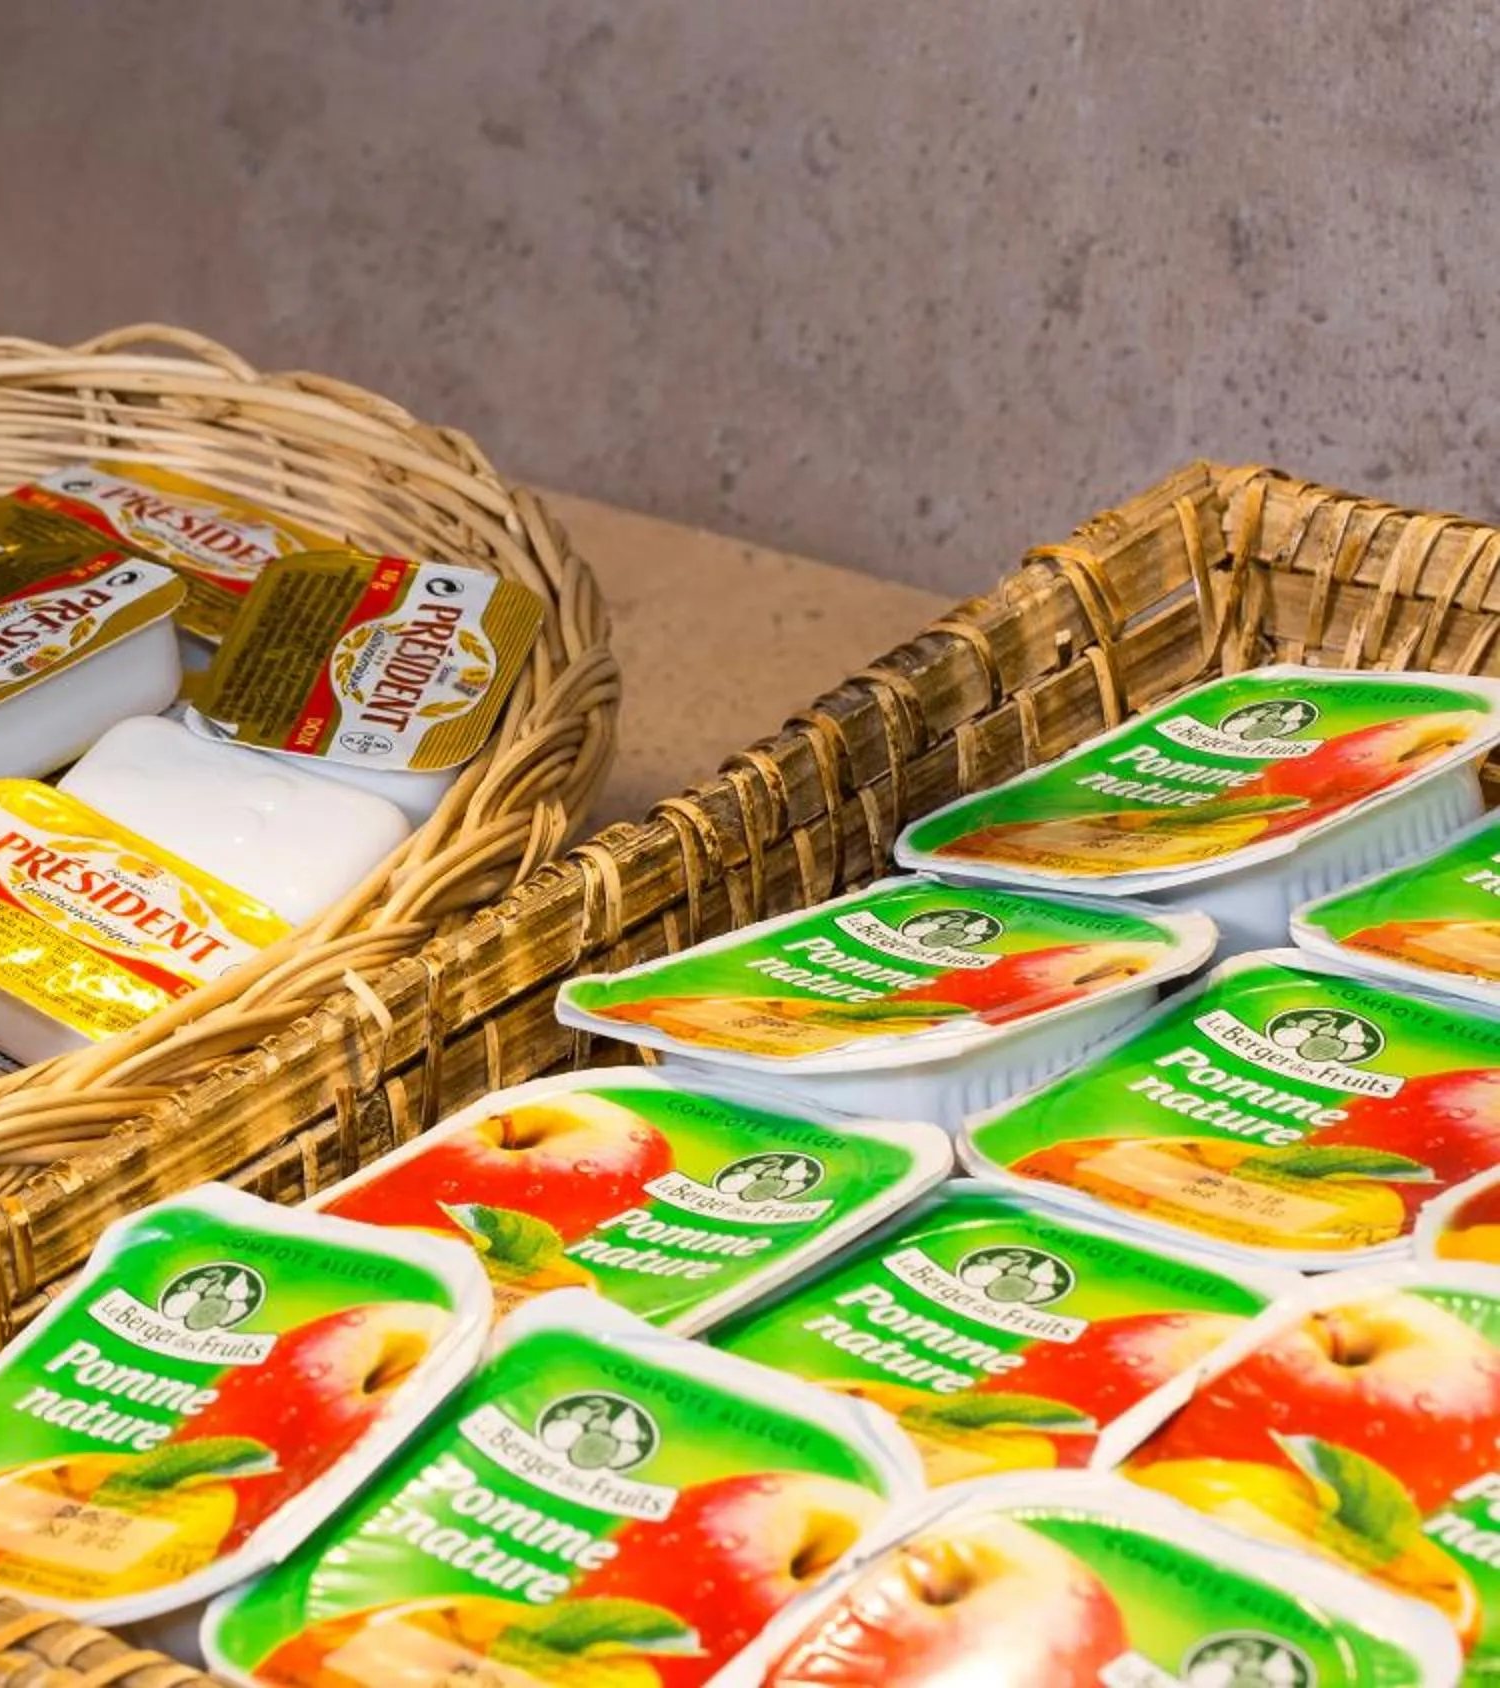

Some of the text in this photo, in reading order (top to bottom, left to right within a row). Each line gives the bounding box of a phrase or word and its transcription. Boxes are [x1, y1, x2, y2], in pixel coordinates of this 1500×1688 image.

[395, 602, 462, 734] PRÉSIDENT
[1109, 744, 1264, 787] Pomme
[1254, 739, 1314, 758] Fruits
[1076, 771, 1216, 807] nature
[746, 957, 887, 1004] nature
[782, 937, 939, 990] Pomme
[928, 946, 988, 967] Fruits
[1154, 1046, 1349, 1129] Pomme
[1221, 1024, 1289, 1071] Berger
[1318, 1064, 1392, 1096] Fruits
[1127, 1075, 1305, 1147] nature
[598, 1207, 772, 1259] Pomme
[669, 1183, 729, 1216] Berger
[755, 1201, 818, 1223] Fruits
[564, 1233, 725, 1281] nature
[118, 1305, 174, 1349] Berger
[198, 1332, 264, 1362] Fruits
[835, 1283, 1025, 1376] Pomme
[911, 1262, 976, 1311] Berger
[1001, 1305, 1075, 1338] Fruits
[43, 1338, 220, 1417] Pomme
[803, 1313, 975, 1396] nature
[14, 1382, 175, 1453] nature
[489, 1426, 561, 1482] Berger
[589, 1474, 664, 1516] Fruits
[426, 1455, 620, 1572] Pomme
[391, 1503, 573, 1605] nature
